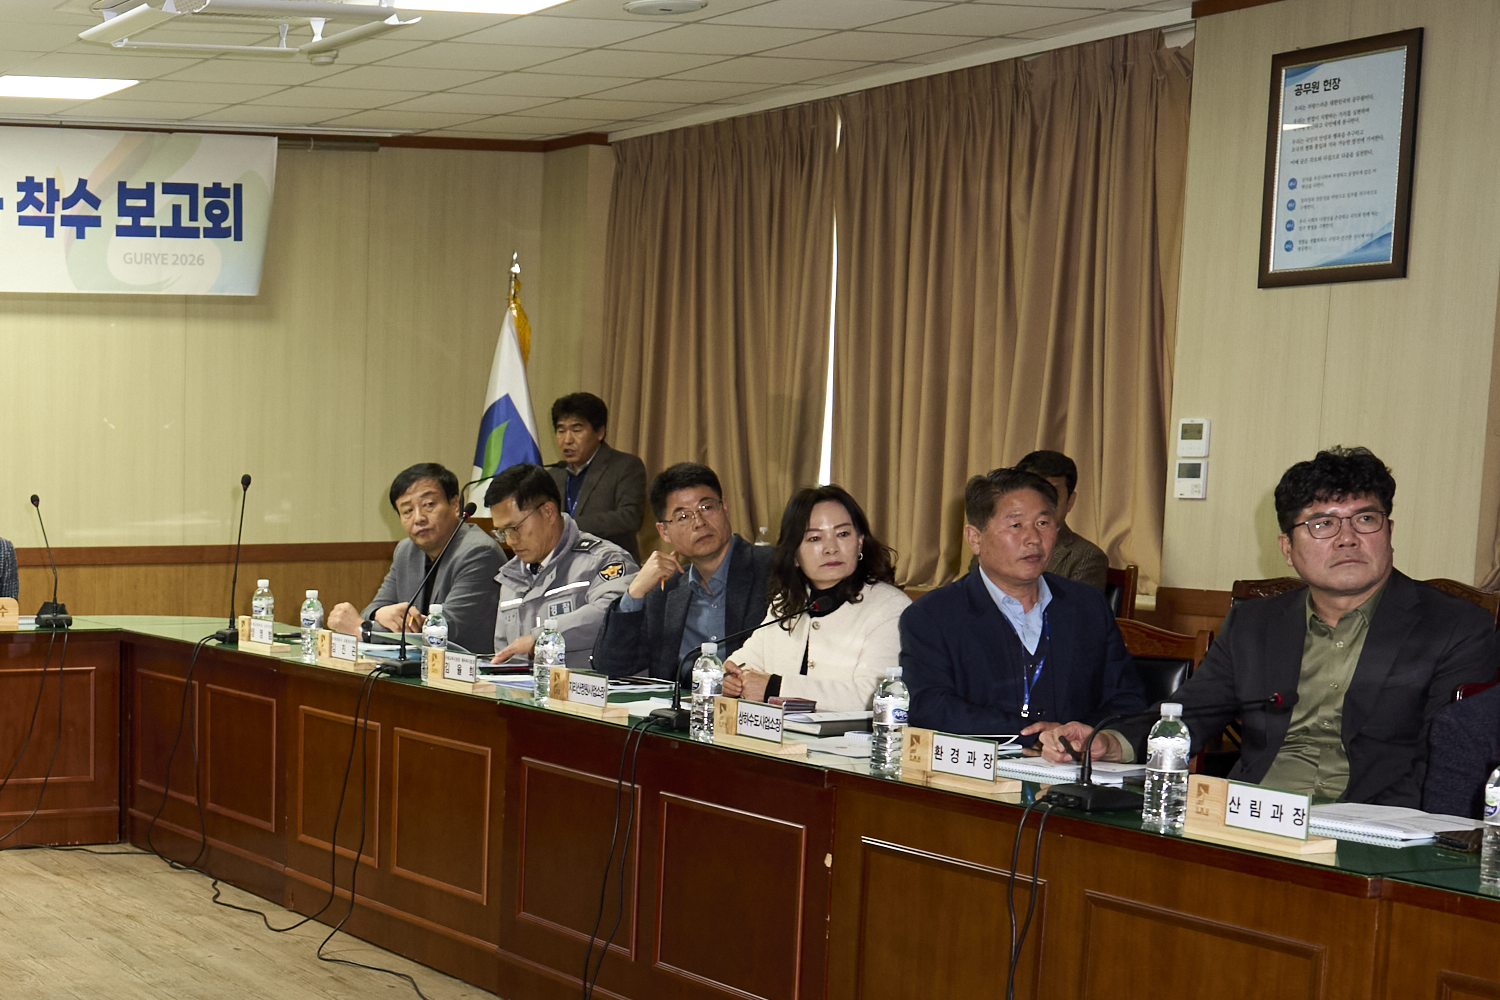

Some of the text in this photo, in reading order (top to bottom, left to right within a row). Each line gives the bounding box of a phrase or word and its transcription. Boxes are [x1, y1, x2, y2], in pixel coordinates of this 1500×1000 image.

[1294, 77, 1341, 97] 공무원 헌장
[16, 176, 102, 240] 착수
[114, 182, 243, 242] 보고회
[122, 251, 206, 268] GURYE 2026
[550, 602, 570, 615] 경찰
[738, 711, 781, 733] 상하수도사업소장
